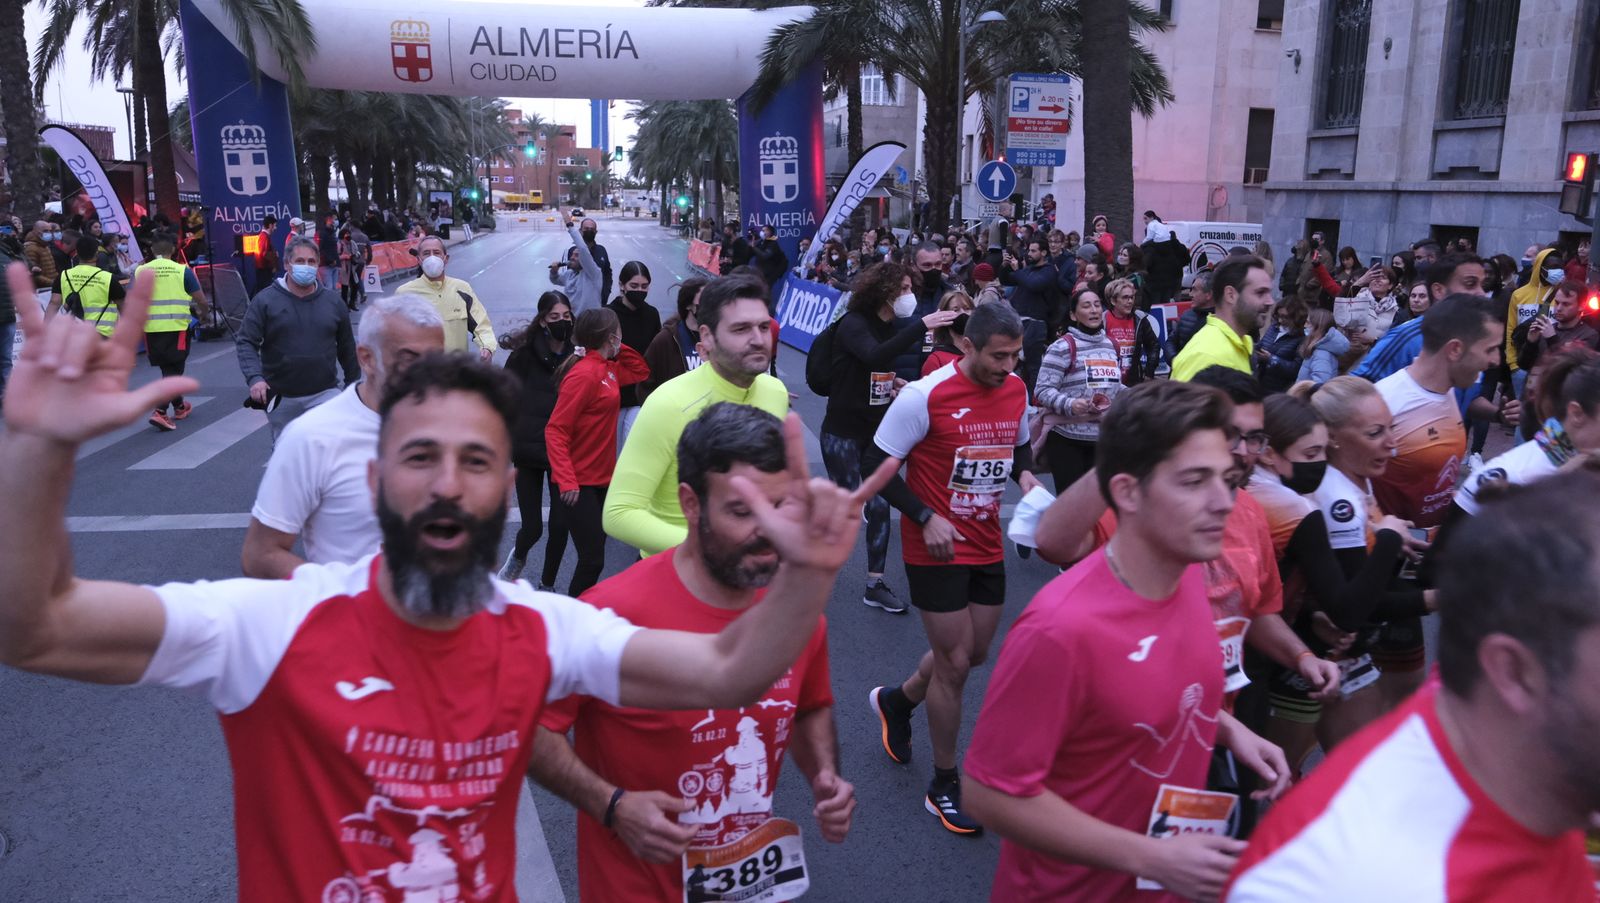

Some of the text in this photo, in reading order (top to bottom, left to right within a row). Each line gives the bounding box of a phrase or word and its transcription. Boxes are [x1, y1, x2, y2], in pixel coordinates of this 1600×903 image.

[470, 23, 640, 60] ALMERÍA
[470, 62, 557, 82] CIUDAD
[214, 201, 292, 222] ALMERÍA
[748, 208, 816, 227] ALMERÍA
[232, 222, 263, 234] CIUD
[368, 272, 376, 285] 5
[1093, 368, 1117, 377] 3366
[969, 460, 1005, 477] 136
[711, 844, 783, 893] 389
